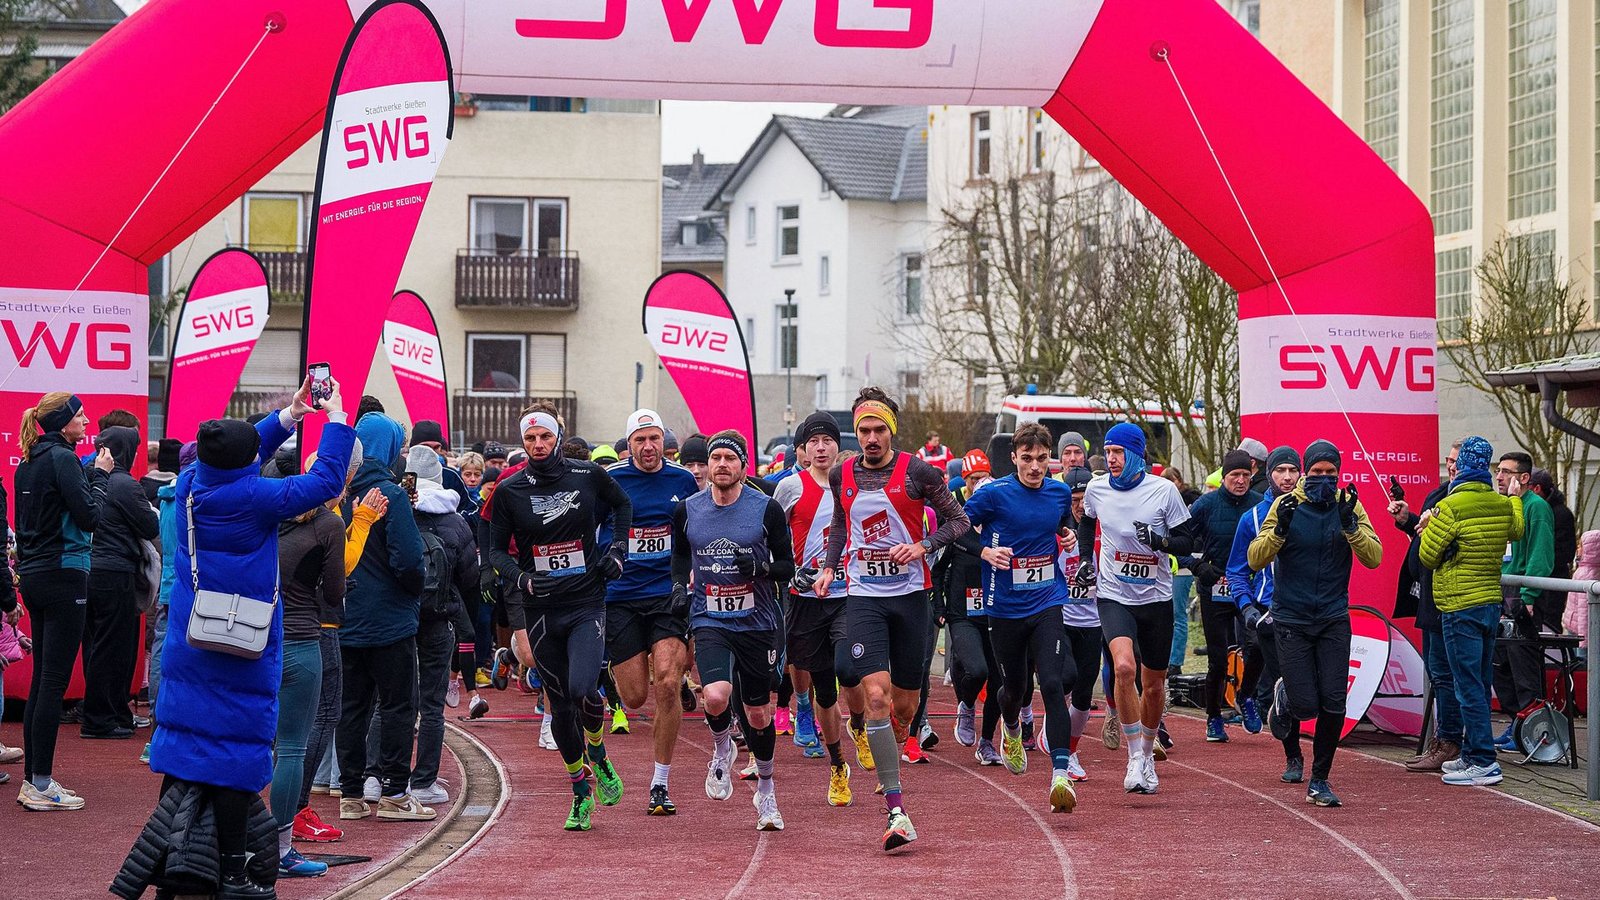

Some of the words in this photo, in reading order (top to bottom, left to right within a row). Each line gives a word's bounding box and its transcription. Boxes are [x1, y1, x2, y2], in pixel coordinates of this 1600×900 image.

[364, 102, 402, 115] Stadtwerke
[404, 100, 427, 109] Gießen
[343, 115, 430, 170] SWG
[322, 214, 334, 224] MIT
[336, 206, 366, 220] ENERGIE.
[368, 202, 381, 212] FÜR
[382, 200, 394, 210] DIE
[396, 195, 424, 207] REGION.
[93, 304, 132, 316] Gießen
[192, 306, 254, 338] SWG
[1328, 328, 1404, 339] Stadtwerke
[0, 320, 131, 370] WG
[1279, 345, 1434, 392] SWG
[1352, 451, 1422, 462] ENERGIE.
[1342, 473, 1370, 482] DIE
[636, 538, 665, 552] 280
[549, 554, 570, 570] 63
[867, 561, 899, 576] 518
[836, 567, 845, 580] 5
[1026, 568, 1043, 583] 21
[1120, 563, 1150, 578] 490
[1068, 586, 1089, 598] 02
[715, 596, 745, 611] 187
